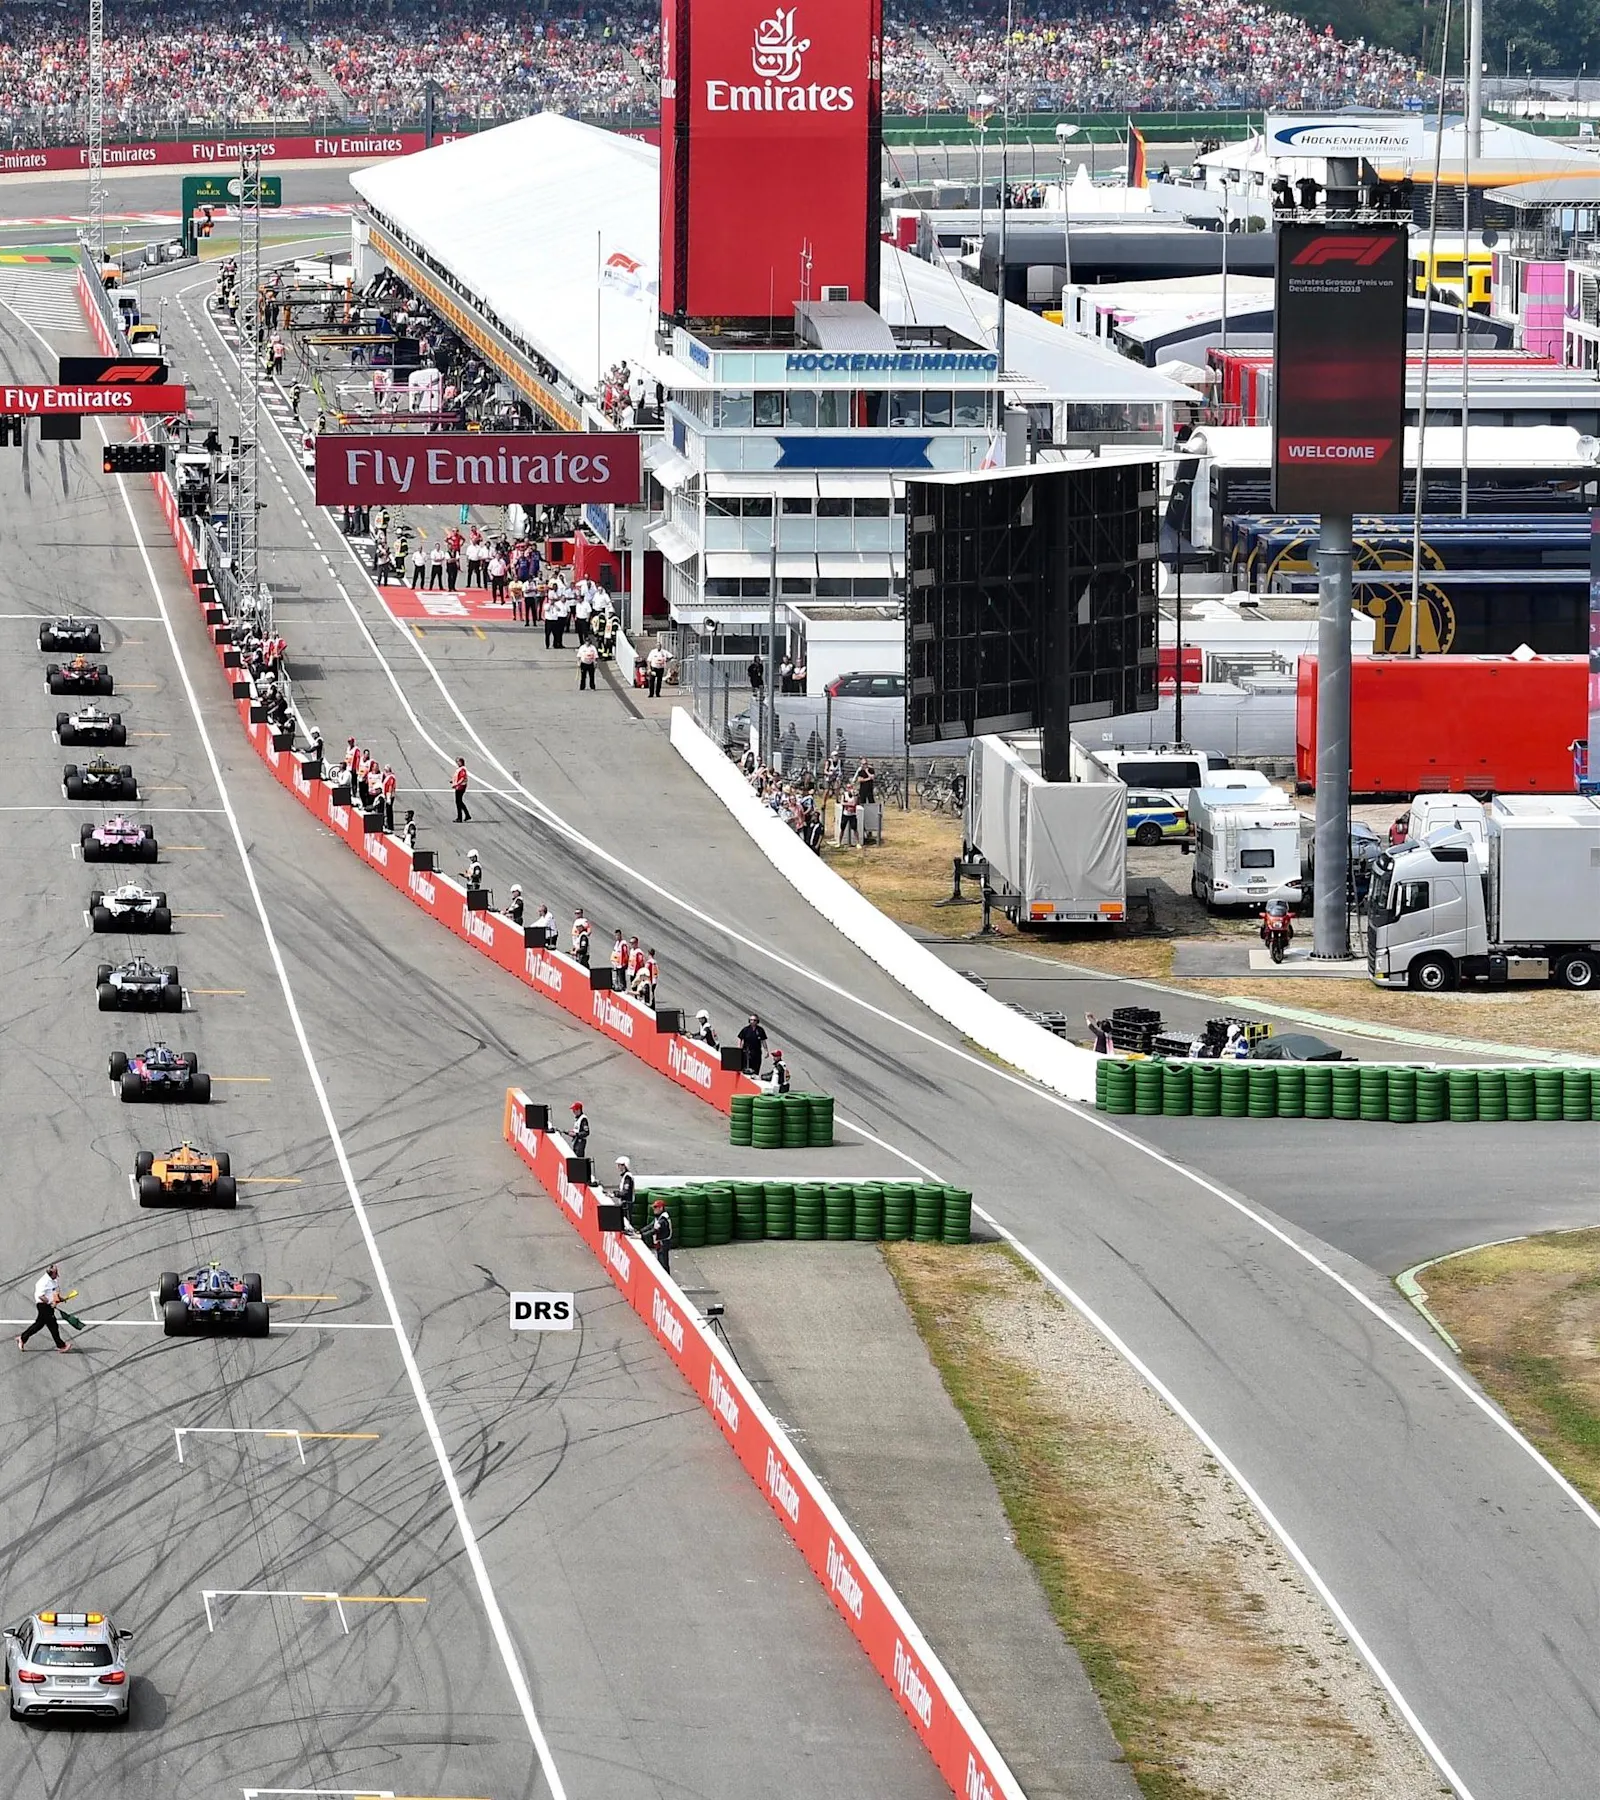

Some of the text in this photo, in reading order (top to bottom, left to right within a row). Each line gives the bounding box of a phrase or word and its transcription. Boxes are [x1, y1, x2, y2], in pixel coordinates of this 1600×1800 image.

[705, 79, 854, 111] Emirates
[103, 147, 157, 163] Emirates
[192, 142, 276, 160] Fly Emirates
[315, 137, 402, 156] Fly Emirates
[1288, 278, 1324, 286] Emirates
[1325, 279, 1357, 287] Grosser
[1357, 279, 1378, 287] Preis
[1288, 285, 1340, 293] Deutschland
[785, 352, 998, 372] HOCKENHEIMRING
[4, 388, 133, 411] Fly Emirates
[345, 446, 610, 493] Fly Emirates
[1288, 445, 1375, 459] WELCOME
[462, 903, 494, 947] Fly Emirates
[526, 947, 563, 993] Fly Emirates
[593, 990, 634, 1039] Fly Emirates
[668, 1038, 712, 1089] Fly Emirates
[515, 1301, 570, 1320] DRS
[652, 1287, 685, 1353] Fly Emirates
[708, 1363, 740, 1434] Fly Emirates
[765, 1446, 800, 1525] Fly Emirates
[826, 1537, 864, 1621] Fly Emirates
[893, 1637, 933, 1729] Fly Emirates
